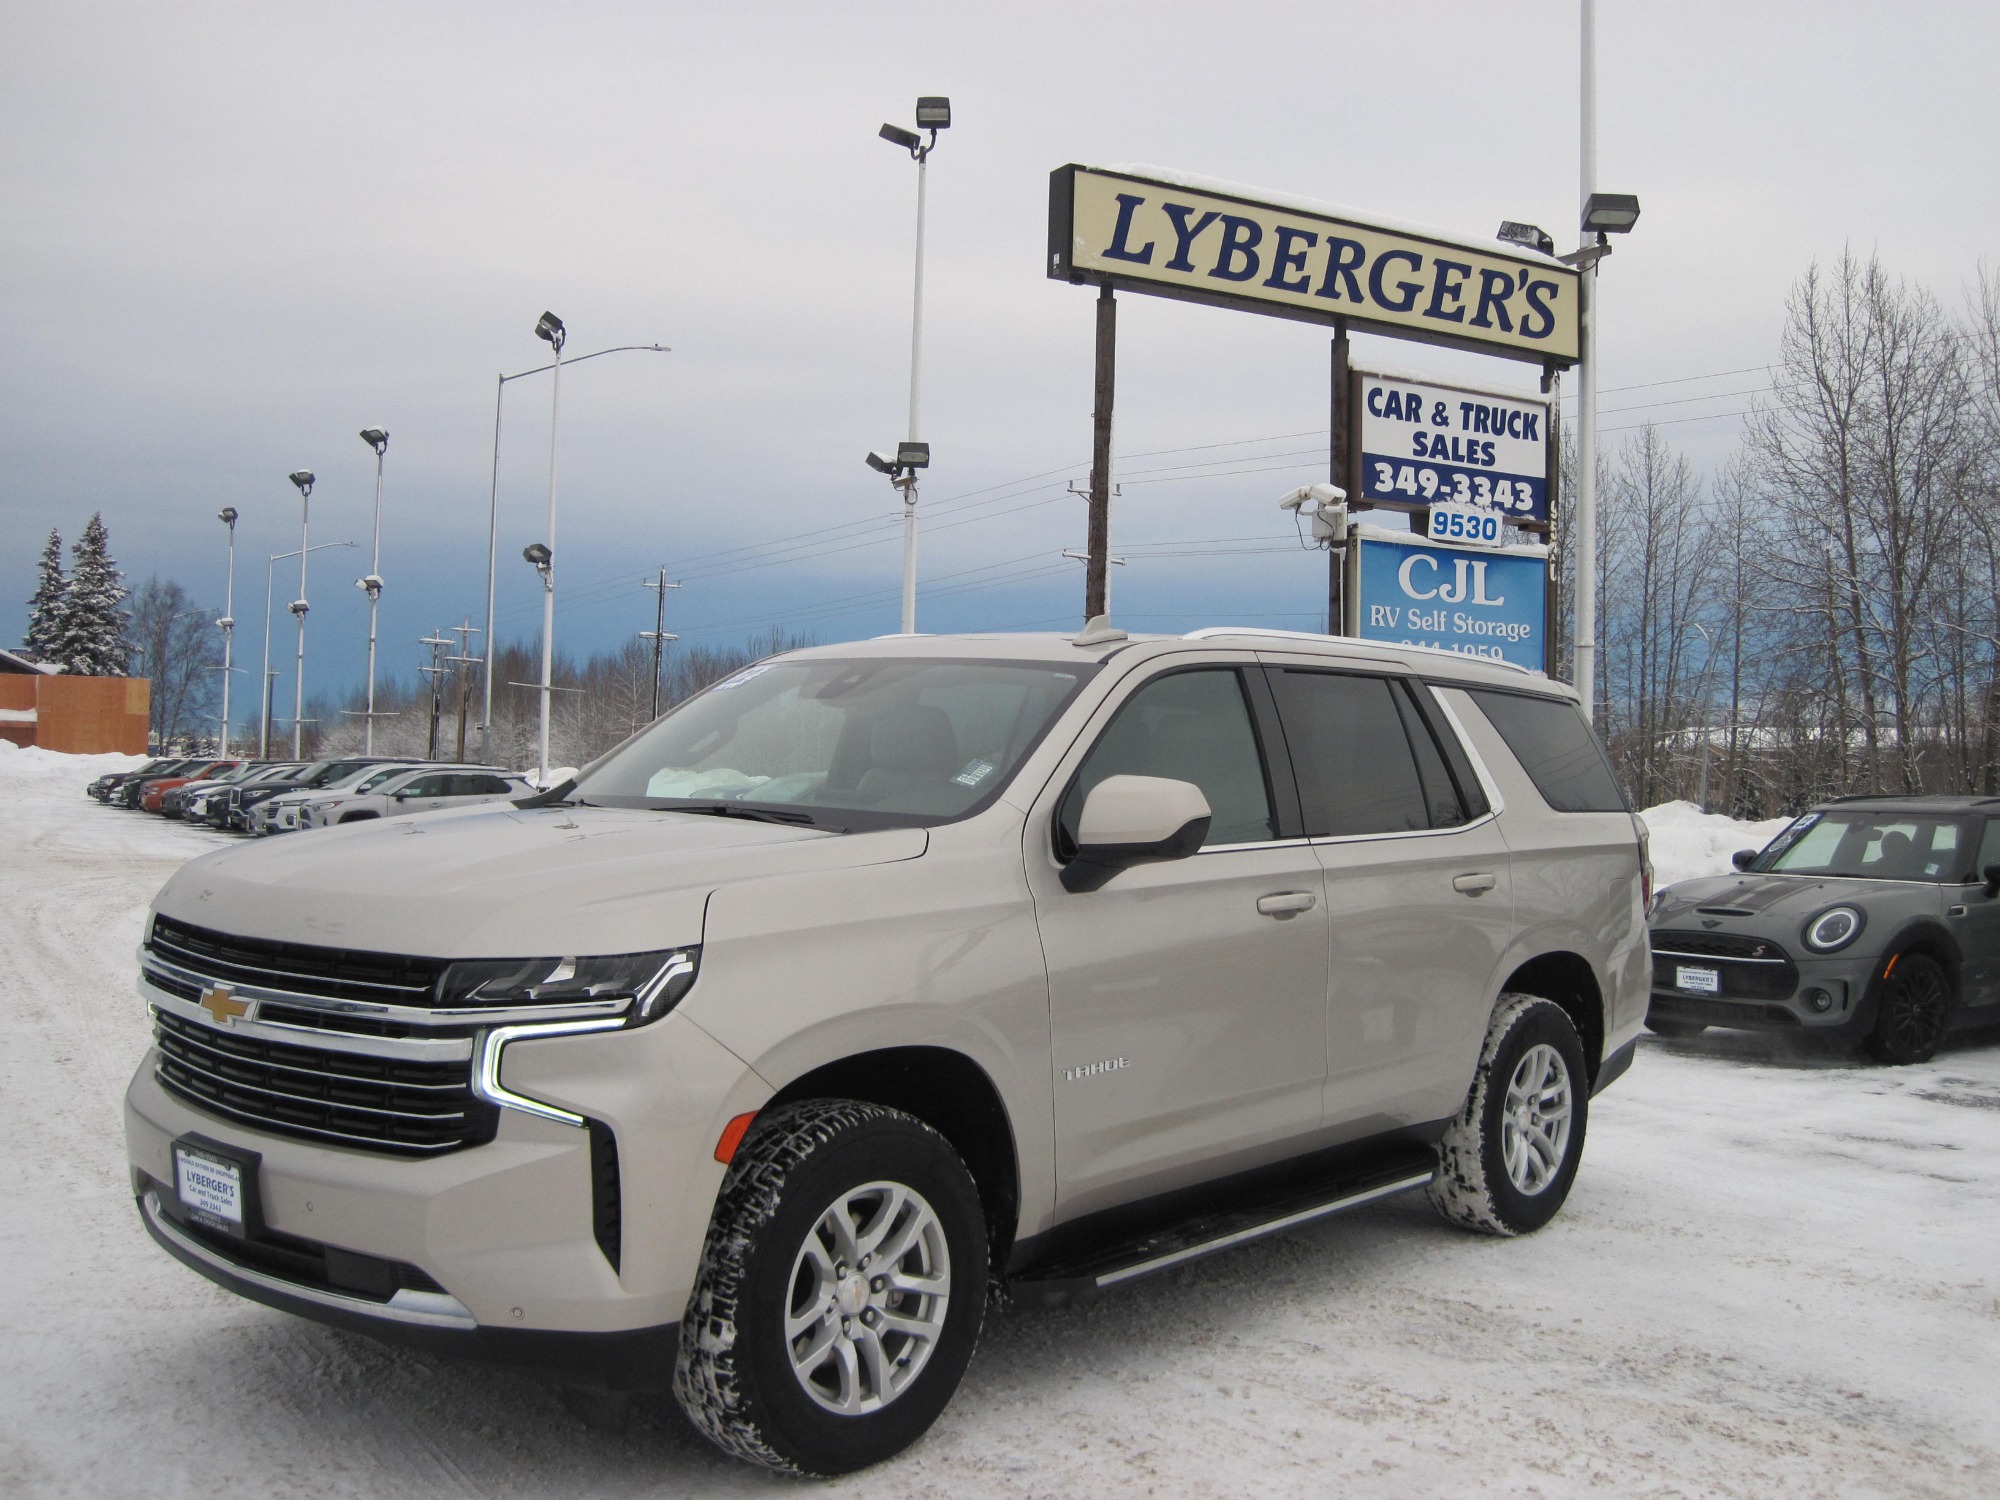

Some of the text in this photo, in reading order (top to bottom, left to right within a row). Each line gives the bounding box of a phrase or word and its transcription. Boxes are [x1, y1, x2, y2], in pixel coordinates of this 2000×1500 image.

[1102, 193, 1560, 339] LYBERGER'S
[1367, 387, 1539, 442] CAR & TRUCK
[1412, 431, 1496, 467] SALES
[1374, 462, 1533, 511] 349-3343
[1433, 511, 1497, 541] 9530
[1398, 553, 1504, 606] CJL
[1370, 605, 1531, 642] RV Self Storage
[1061, 1056, 1131, 1081] TAHOE
[186, 1170, 235, 1197] LYBERGER'S
[189, 1184, 233, 1207] Car and Truck Sales
